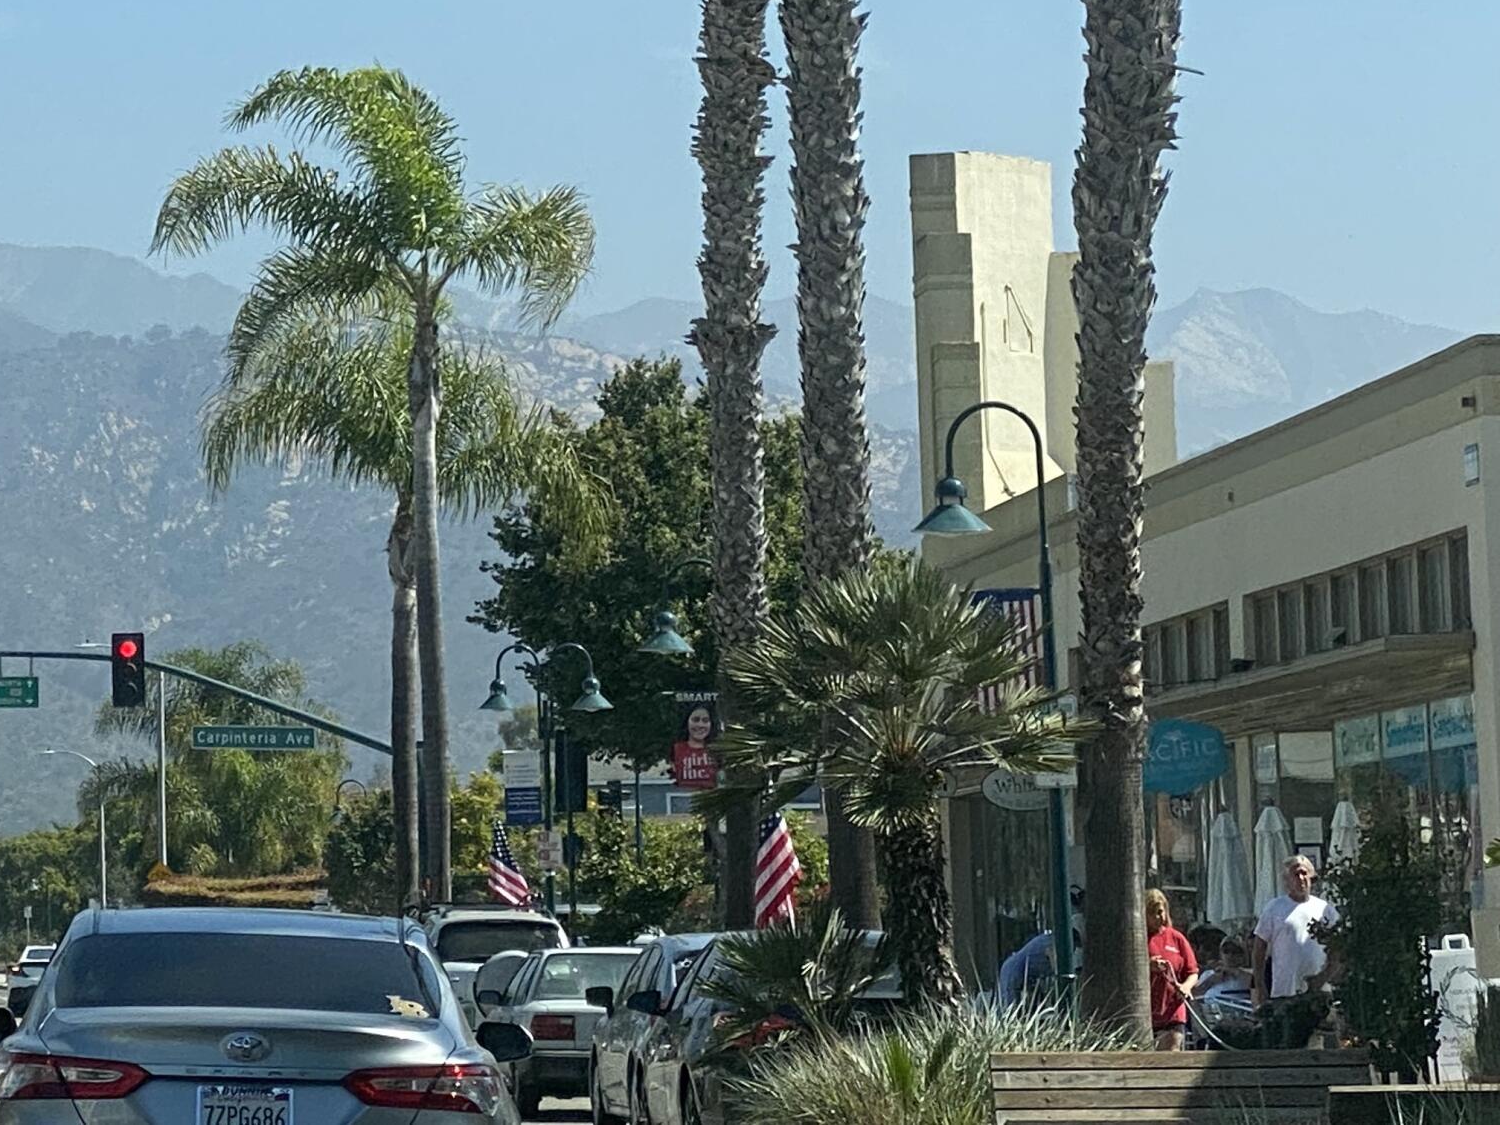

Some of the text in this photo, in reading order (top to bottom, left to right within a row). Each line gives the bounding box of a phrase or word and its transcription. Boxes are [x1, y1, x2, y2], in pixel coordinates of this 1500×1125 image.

[675, 692, 719, 703] SMART
[196, 730, 310, 746] Carpinteria Ave
